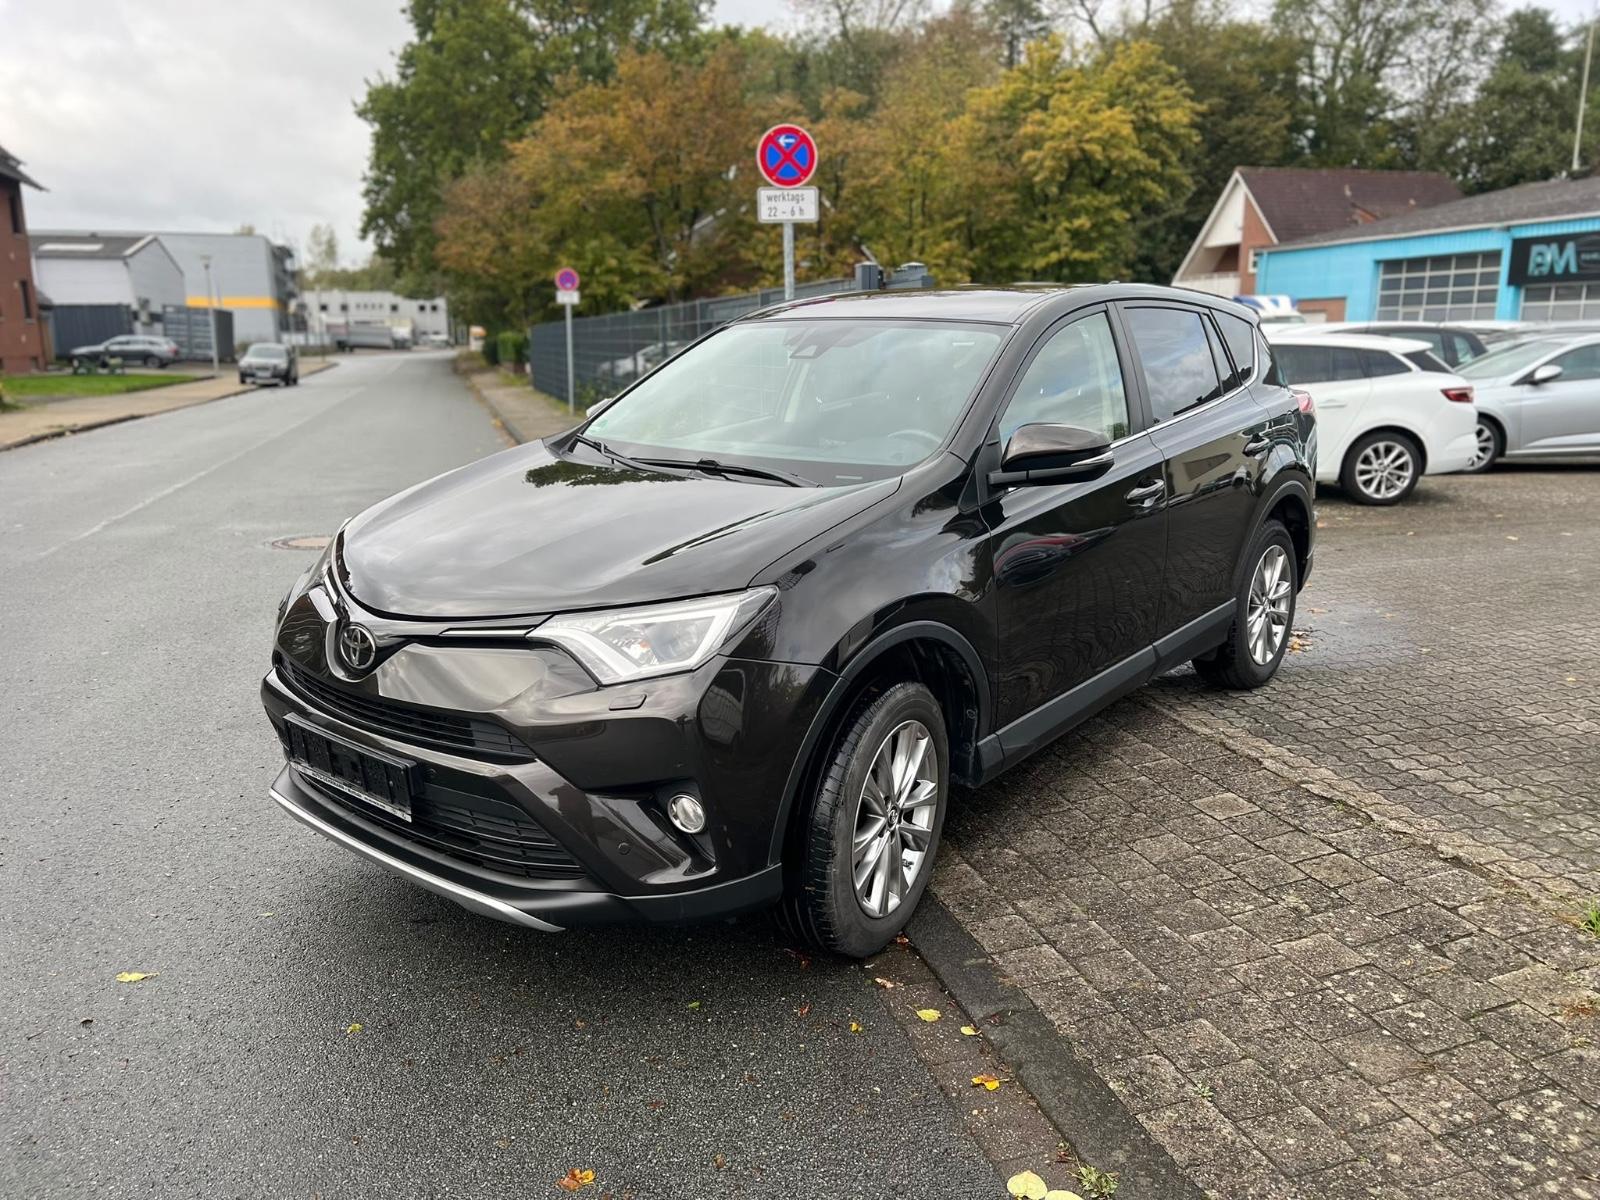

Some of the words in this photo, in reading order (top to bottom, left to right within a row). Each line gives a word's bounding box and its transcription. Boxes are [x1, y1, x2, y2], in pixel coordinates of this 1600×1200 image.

[766, 192, 805, 204] werktags
[768, 206, 778, 217] 22
[790, 206, 796, 217] 6
[799, 206, 805, 216] h
